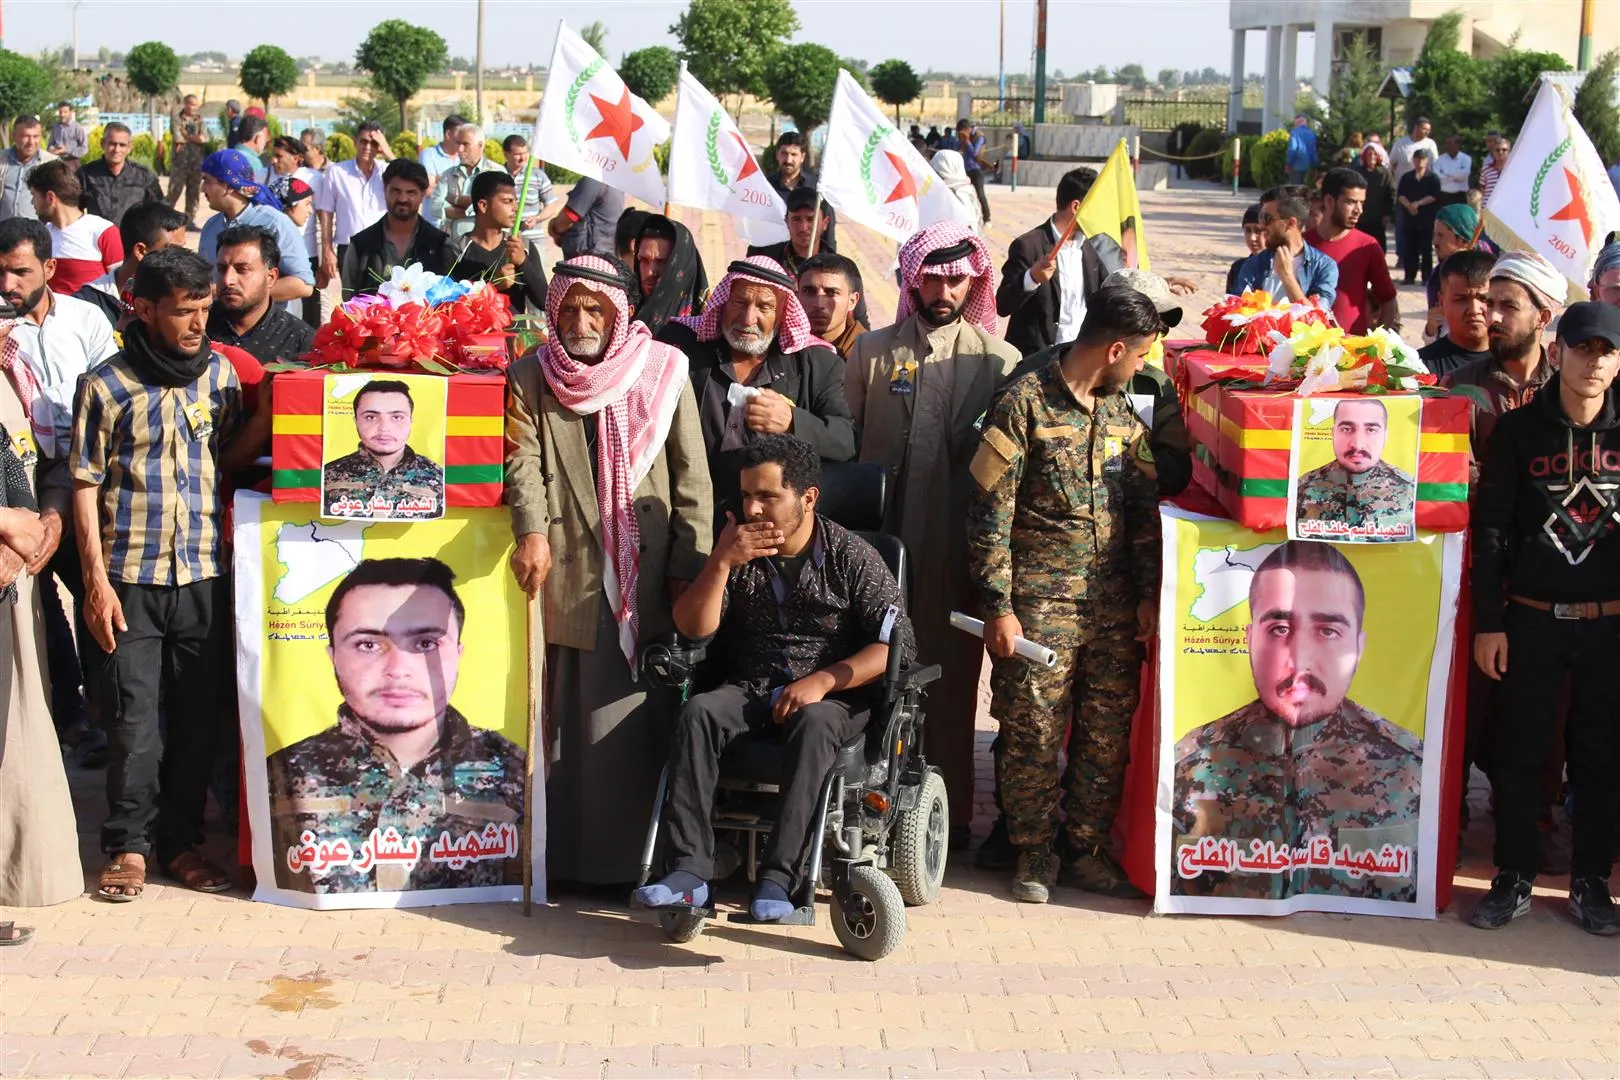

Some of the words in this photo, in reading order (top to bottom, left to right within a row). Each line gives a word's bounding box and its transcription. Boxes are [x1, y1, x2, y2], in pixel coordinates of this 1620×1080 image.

[584, 148, 617, 173] 2003
[740, 188, 773, 208] 2003
[885, 211, 913, 233] 200
[1547, 234, 1577, 260] 2003
[1528, 443, 1620, 477] adida
[331, 497, 362, 514] عوض
[366, 496, 393, 514] بشار
[397, 497, 436, 515] الشهيد
[1376, 522, 1409, 538] الشهيد
[299, 619, 327, 631] Sûriy
[288, 830, 350, 873] عوض
[356, 829, 419, 869] بشار
[432, 825, 516, 865] الشهيد
[1180, 839, 1235, 876] المفلح
[1238, 841, 1290, 871] خلف
[1335, 847, 1409, 875] الشهيد
